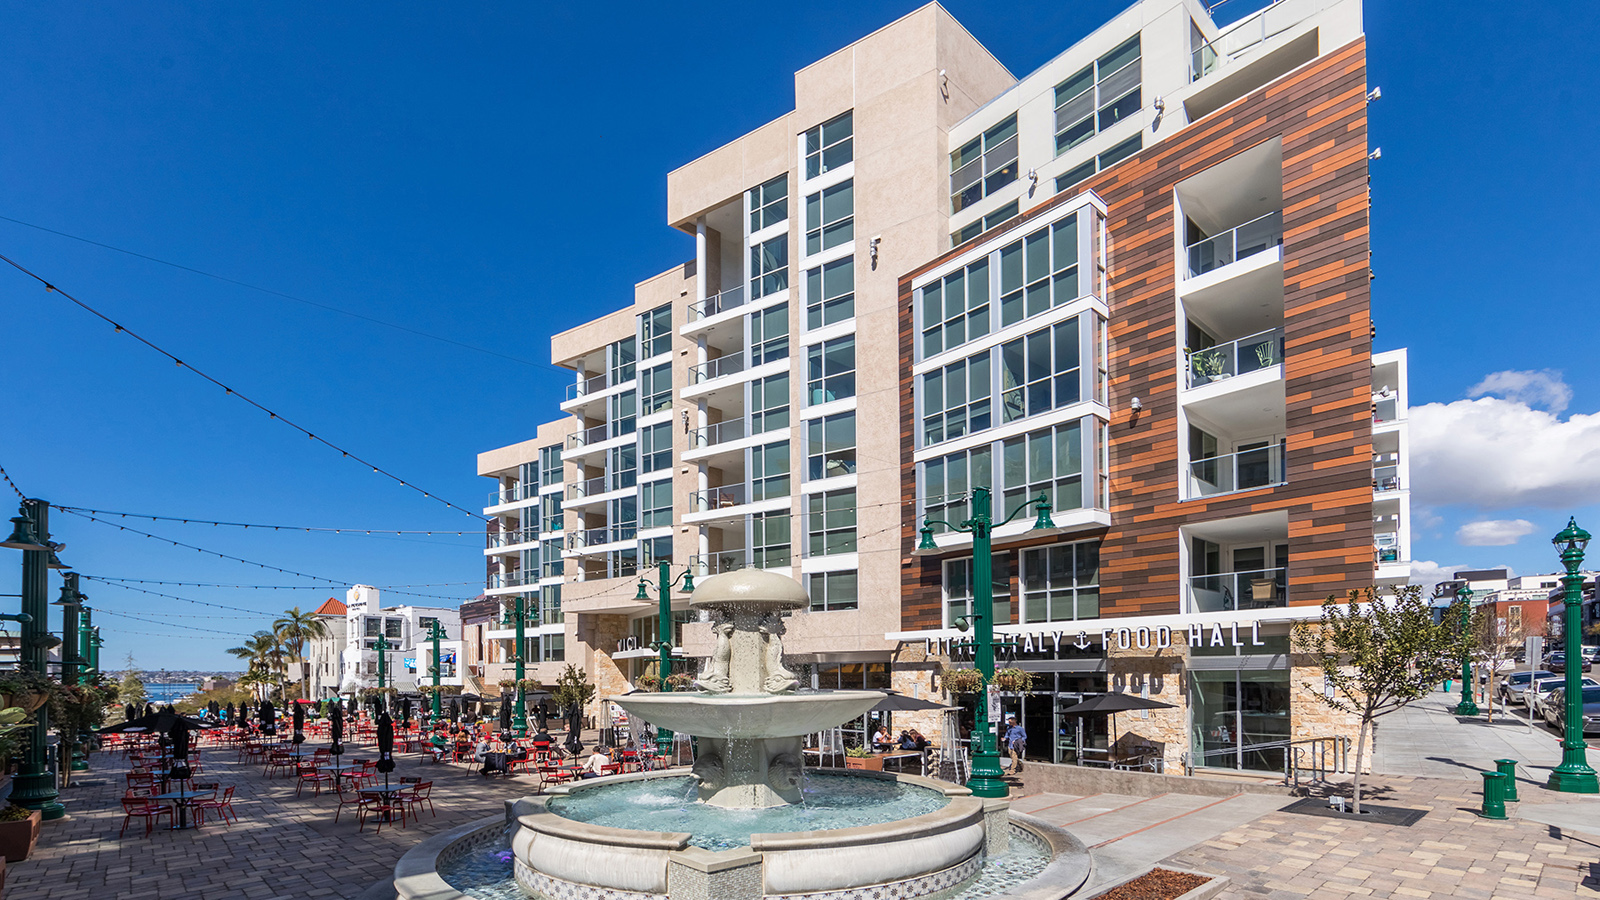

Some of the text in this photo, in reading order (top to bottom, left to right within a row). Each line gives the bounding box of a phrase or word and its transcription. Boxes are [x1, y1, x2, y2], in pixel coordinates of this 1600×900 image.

[925, 620, 1265, 656] LITTL ITALY FOOD HALL
